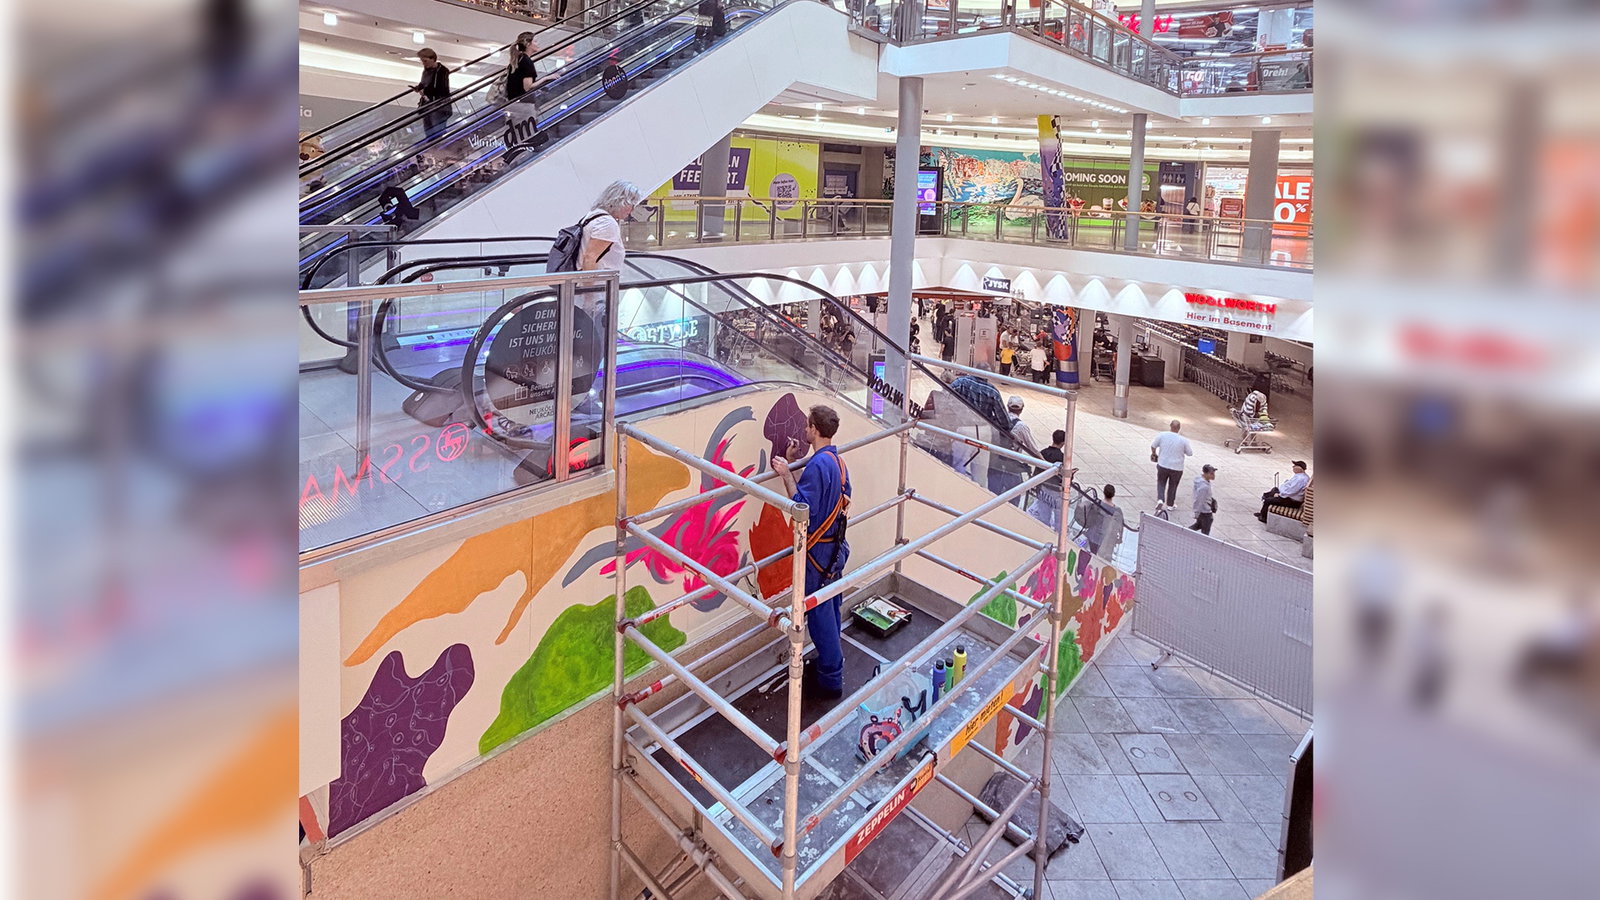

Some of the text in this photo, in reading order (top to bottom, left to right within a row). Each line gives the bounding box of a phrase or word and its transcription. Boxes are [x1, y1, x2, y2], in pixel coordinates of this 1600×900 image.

[504, 116, 539, 148] dm
[680, 170, 701, 182] FEE
[1064, 172, 1126, 184] OMING SOON
[988, 280, 1009, 290] JYSK
[1184, 293, 1277, 314] WOOLWORTH
[535, 309, 556, 320] DEIN
[522, 321, 557, 334] SICHER
[1186, 312, 1273, 331] Hier im Basement
[509, 337, 524, 348] IST
[525, 335, 544, 346] UNS
[523, 344, 556, 359] NEUKÖL
[535, 411, 554, 420] ARCAD
[857, 789, 906, 845] ZEPPELIN
